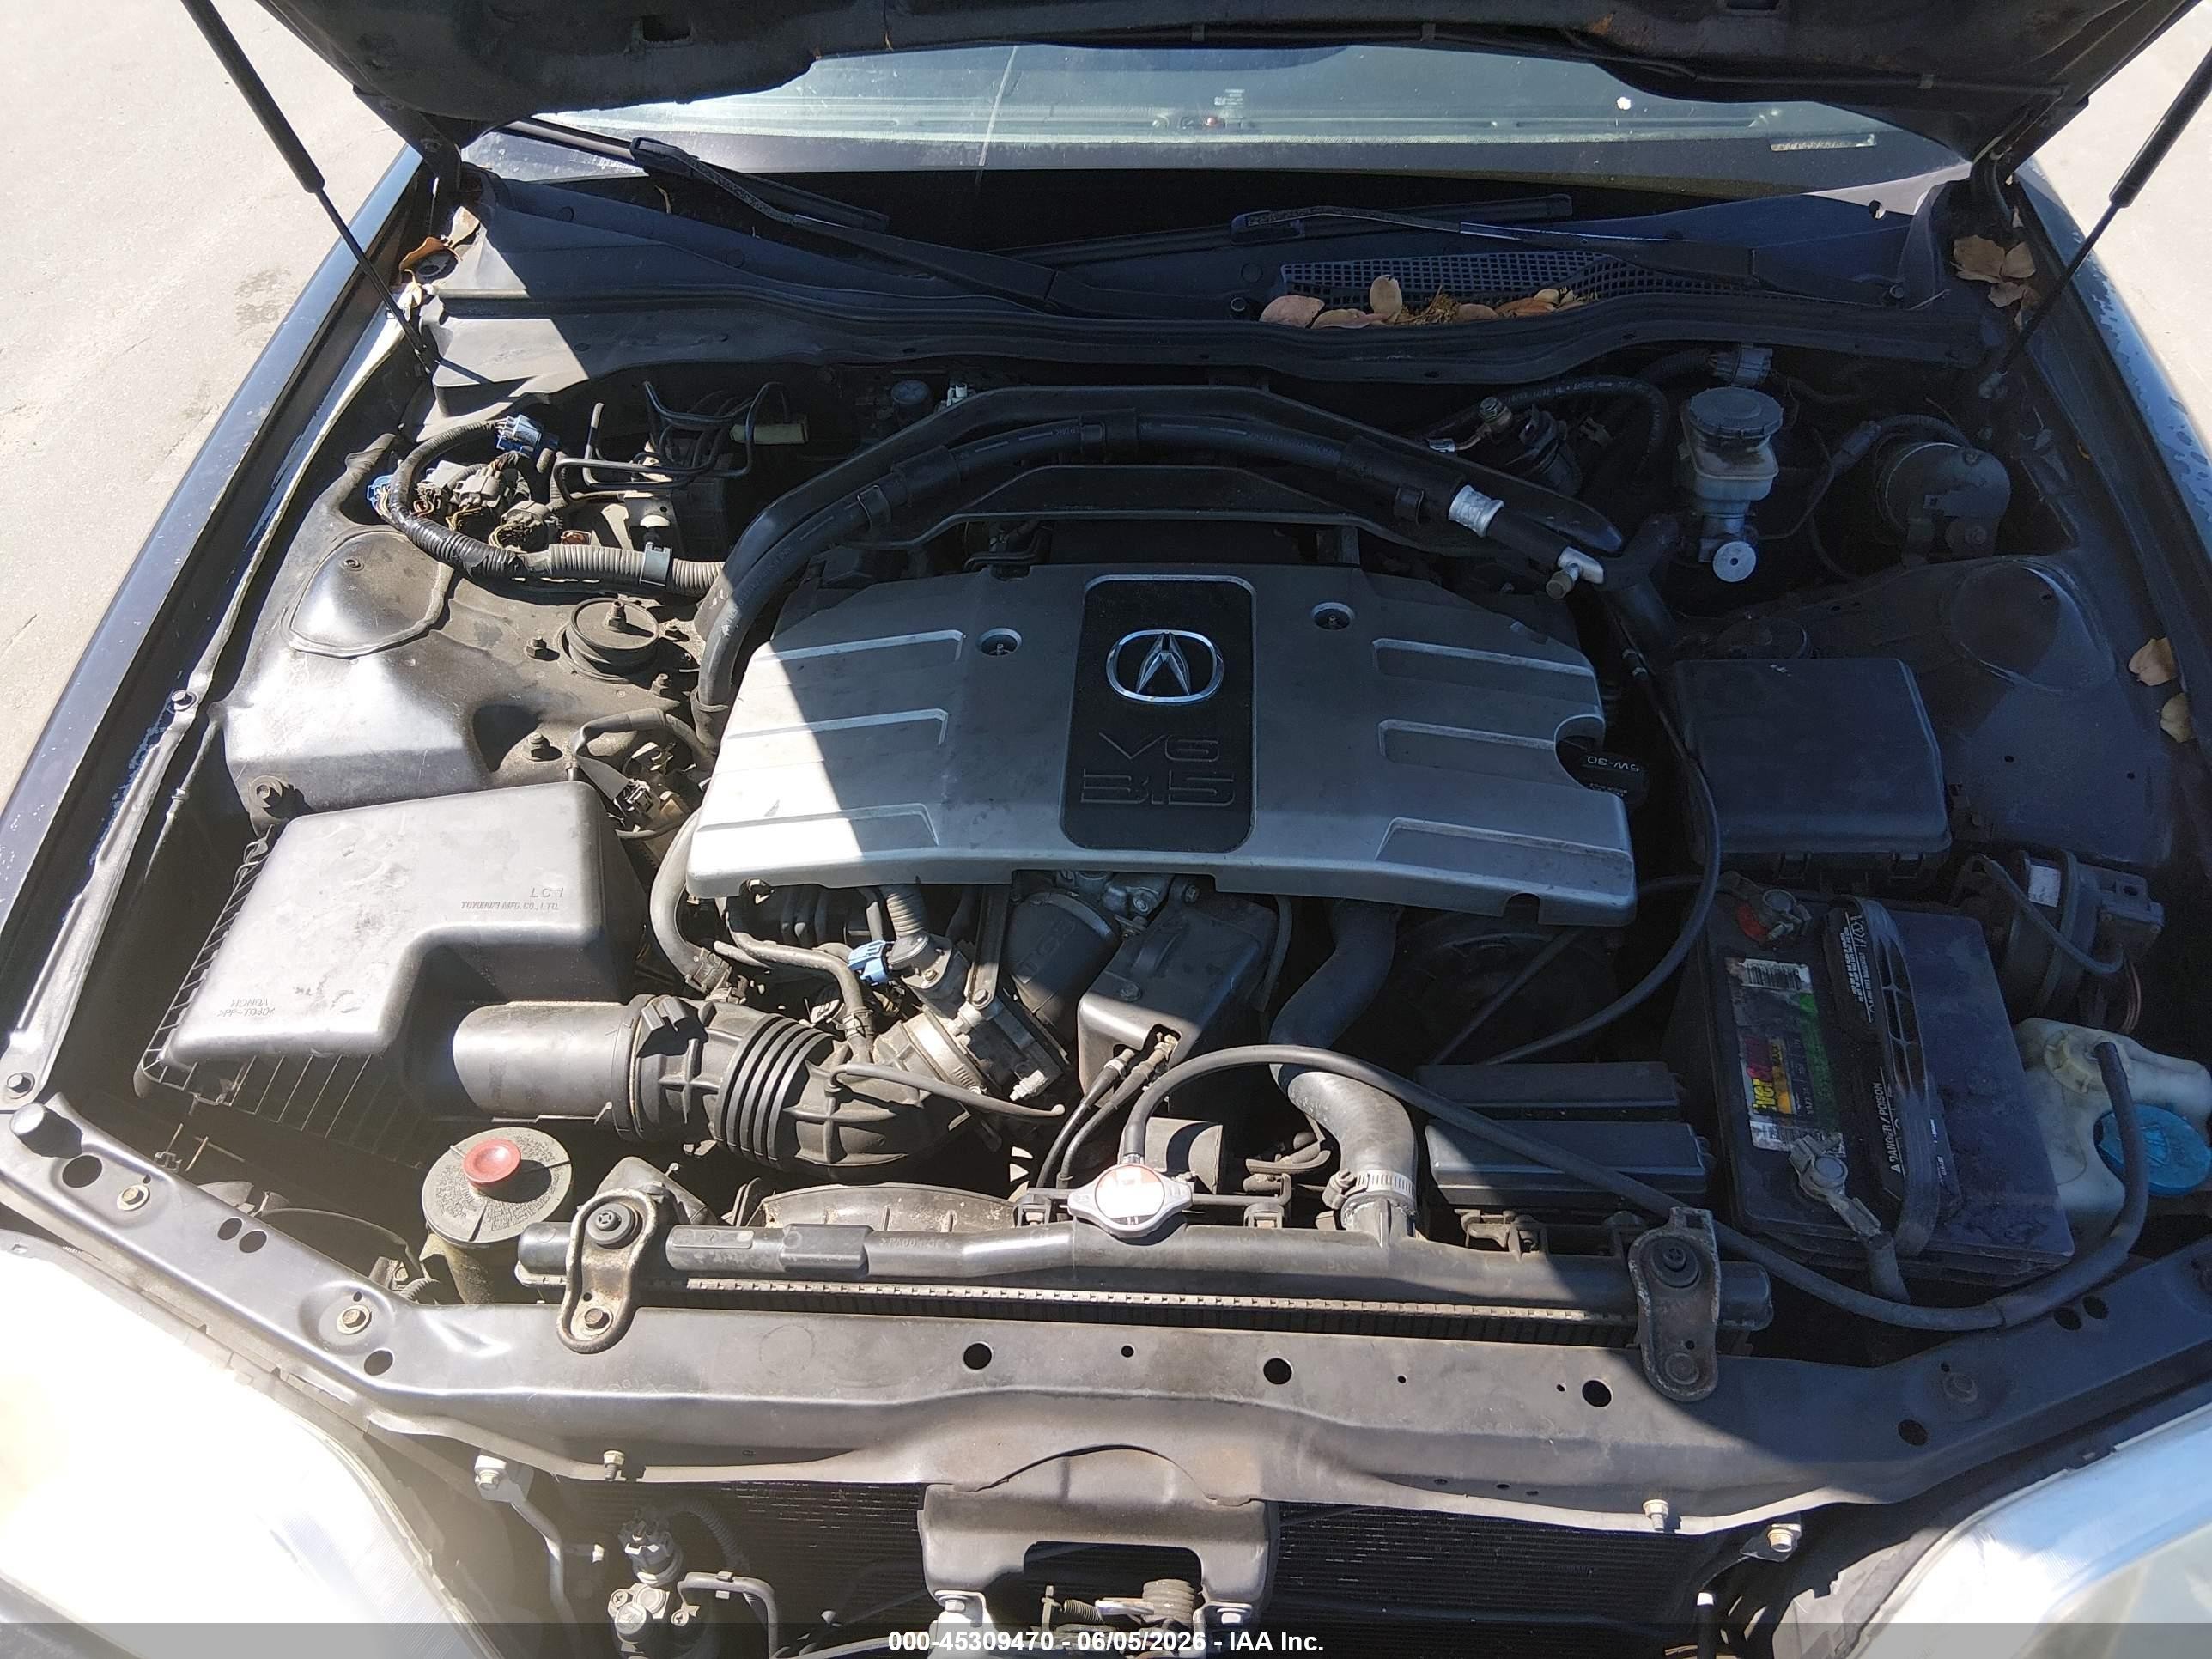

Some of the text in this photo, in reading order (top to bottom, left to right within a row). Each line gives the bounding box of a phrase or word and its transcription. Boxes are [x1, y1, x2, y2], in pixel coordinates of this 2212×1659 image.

[1098, 732, 1220, 763] V6
[1587, 756, 1639, 773] 5W-30
[1080, 768, 1237, 808] 3.5
[1873, 1082, 1890, 1116] POISON
